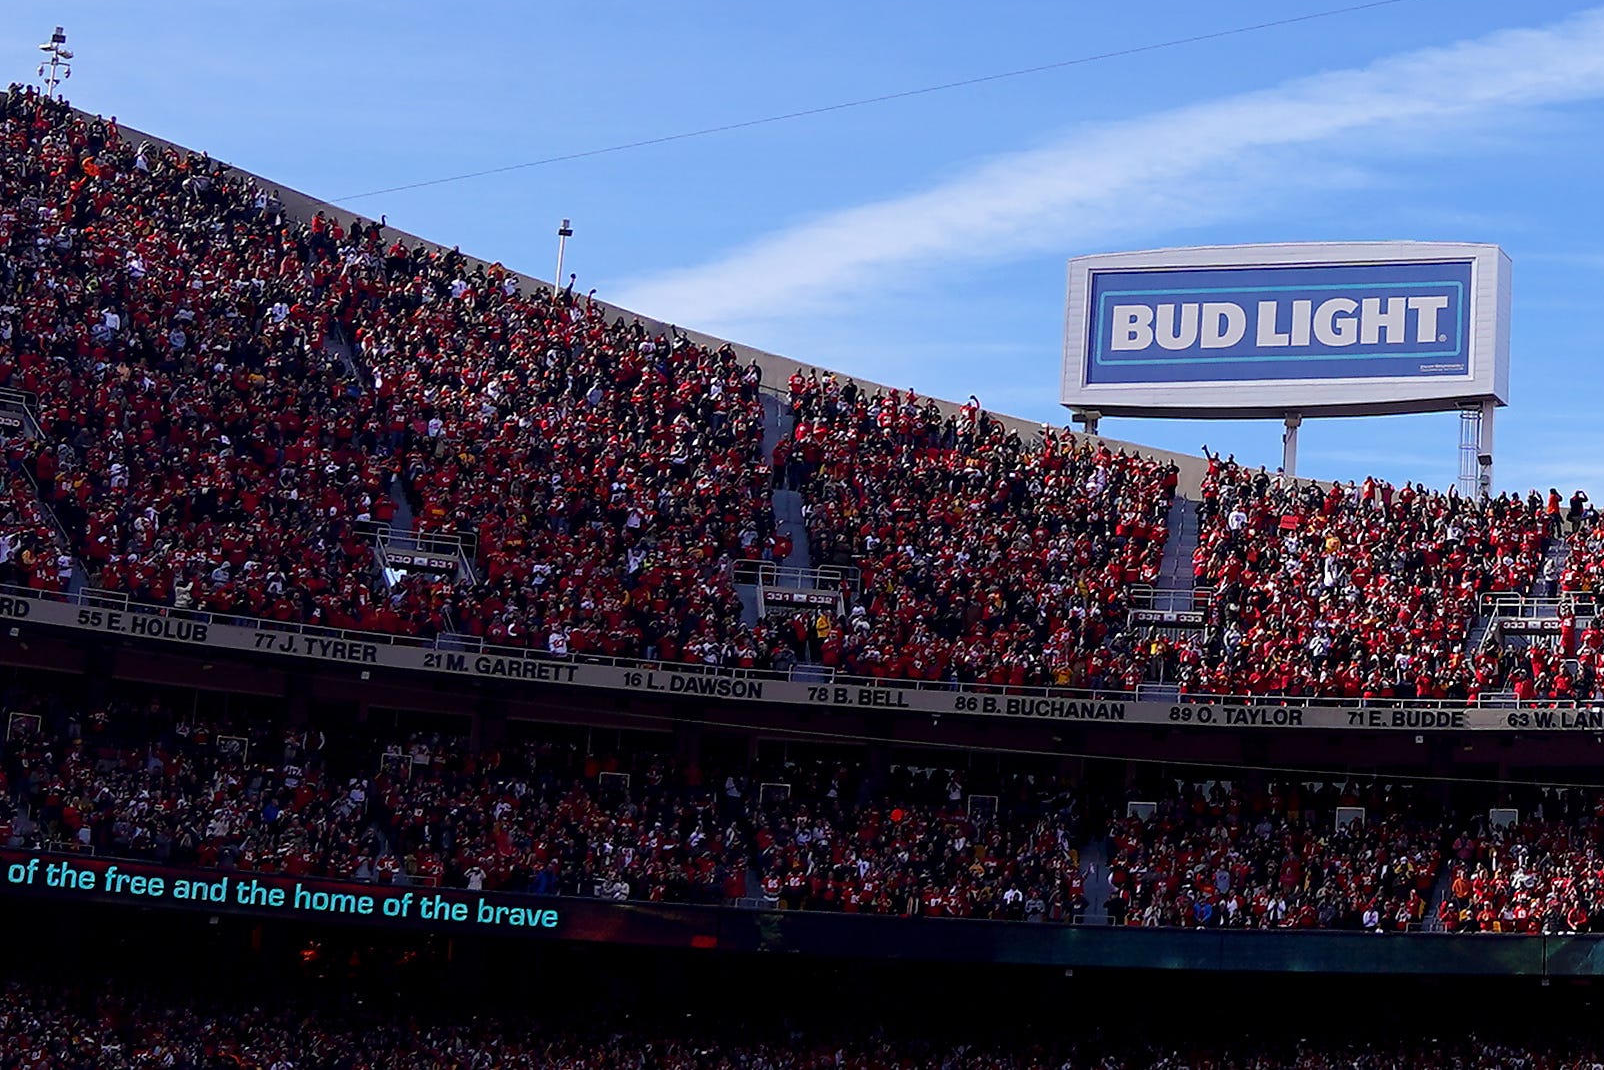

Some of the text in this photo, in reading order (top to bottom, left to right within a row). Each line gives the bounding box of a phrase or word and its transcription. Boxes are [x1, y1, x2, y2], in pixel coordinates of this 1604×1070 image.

[1111, 296, 1448, 351] BUD LIGHT
[78, 610, 102, 627] 55
[107, 613, 126, 631] E.
[131, 614, 208, 642] HOLUB
[254, 633, 376, 663] 77 J. TYRER
[424, 653, 578, 682] 21 M. GARRETT
[624, 672, 762, 699] 16 L. DAWSON
[808, 686, 908, 707] 78 B. BELL
[955, 696, 1125, 720] 86 B. BUCHANAN
[1169, 707, 1303, 725] 89 O. TAYLOR
[1348, 711, 1464, 727] 71 E. BUDDE
[1508, 712, 1530, 726] 63
[1534, 712, 1556, 727] W.
[8, 858, 559, 928] of the free and the home of the brave
